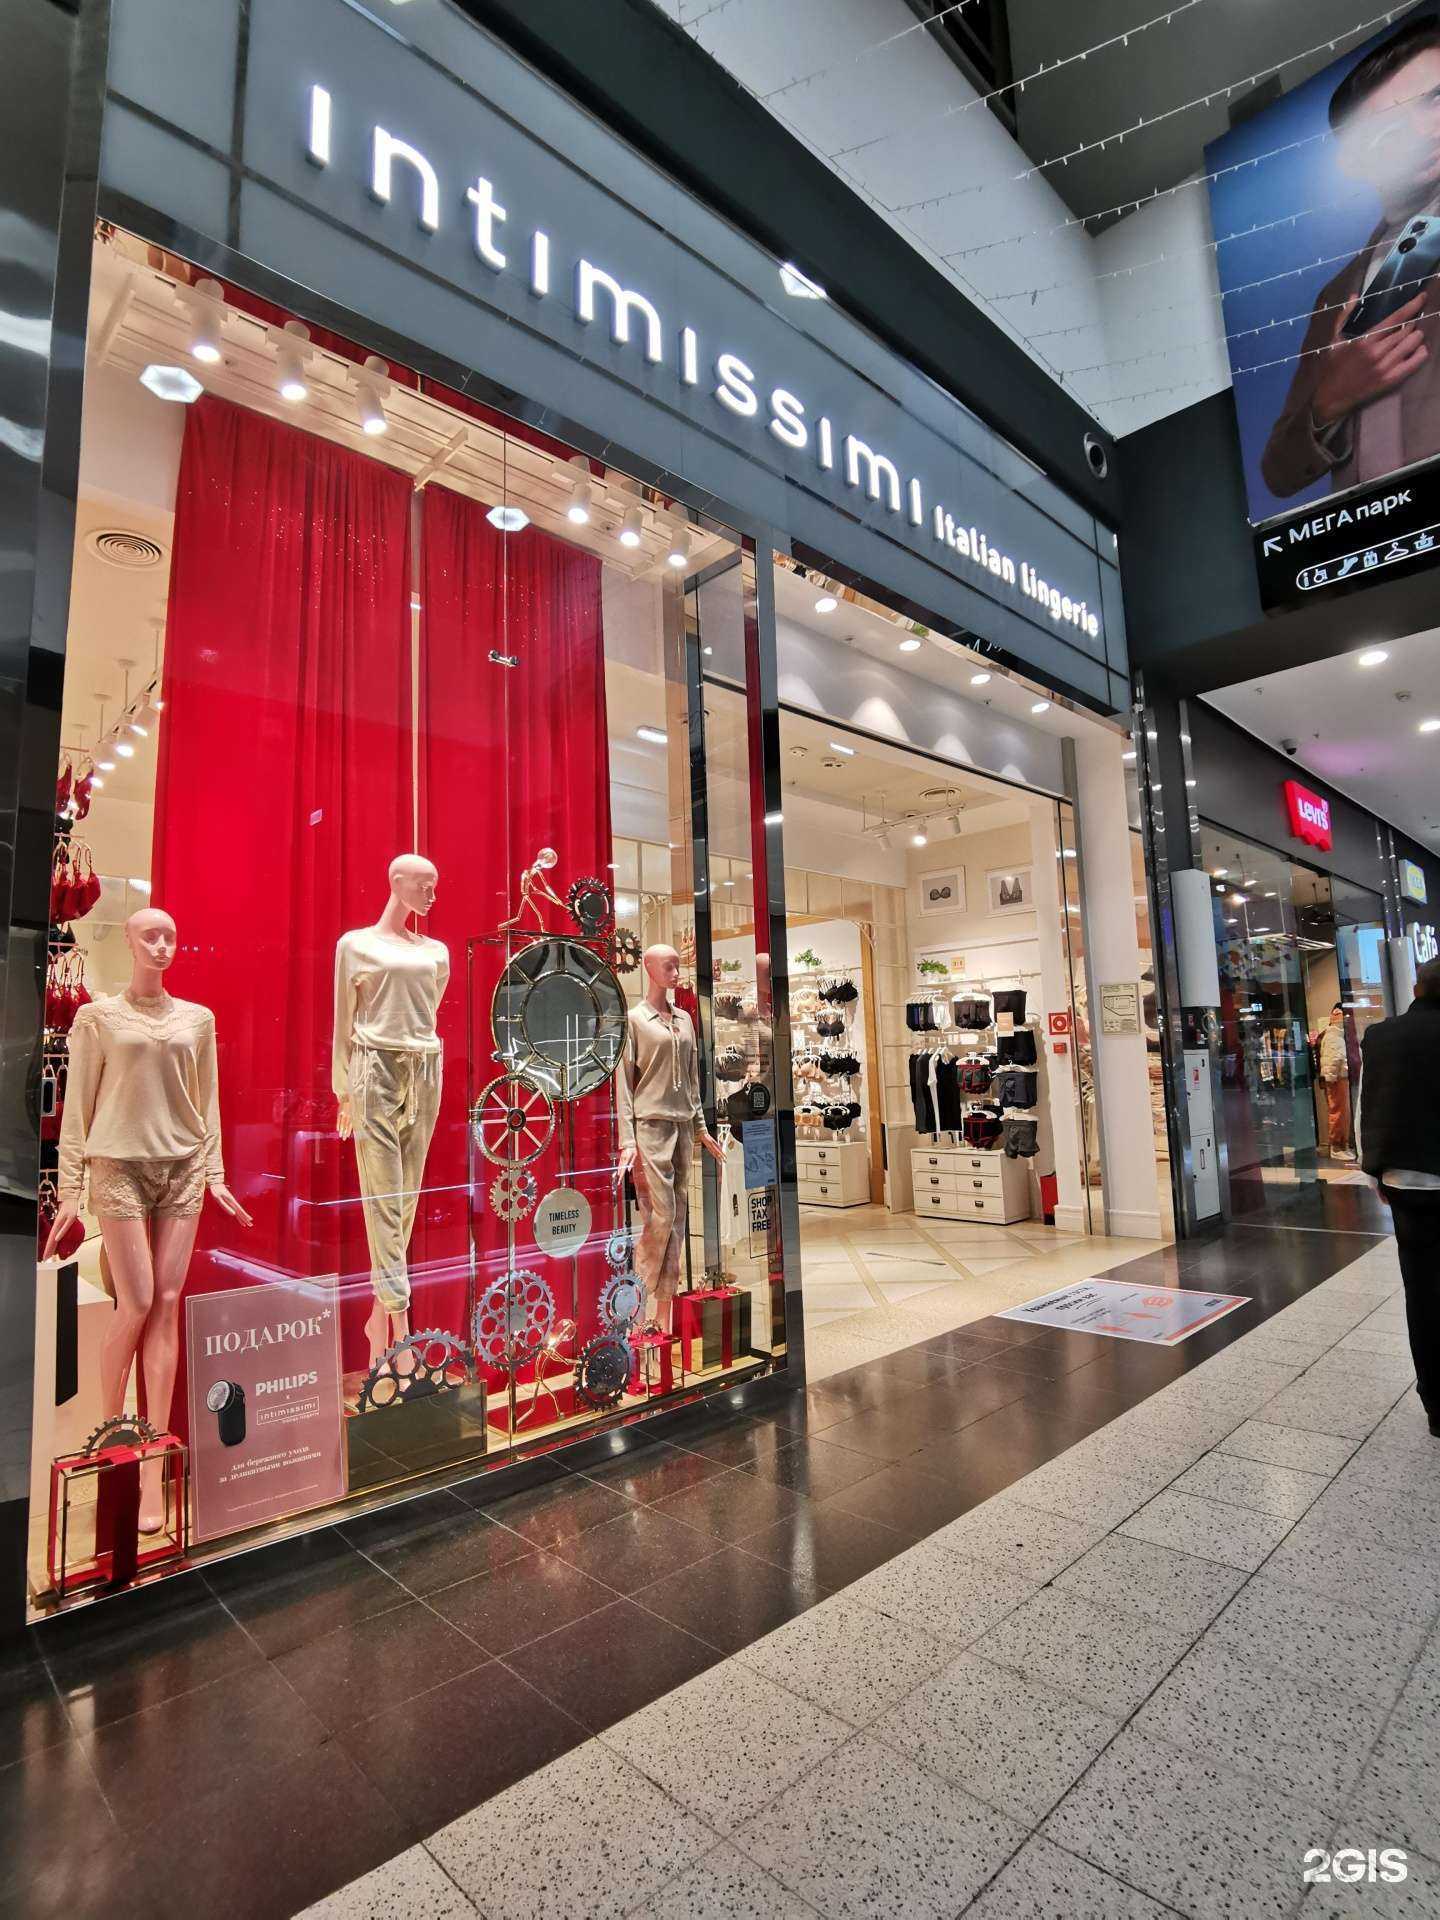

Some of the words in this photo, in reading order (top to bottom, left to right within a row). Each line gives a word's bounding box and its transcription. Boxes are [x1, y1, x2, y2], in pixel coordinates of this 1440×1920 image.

[1288, 509, 1353, 544] МЕГА
[1355, 489, 1413, 521] парк
[933, 505, 1016, 585] Italian
[1020, 562, 1099, 638] lingerie
[751, 1195, 772, 1209] SHOP
[549, 1209, 580, 1222] TIMELESS
[751, 1208, 768, 1221] TAX
[552, 1223, 577, 1235] BEAUTY
[751, 1220, 772, 1233] FREE
[255, 1370, 318, 1396] PHILIPS
